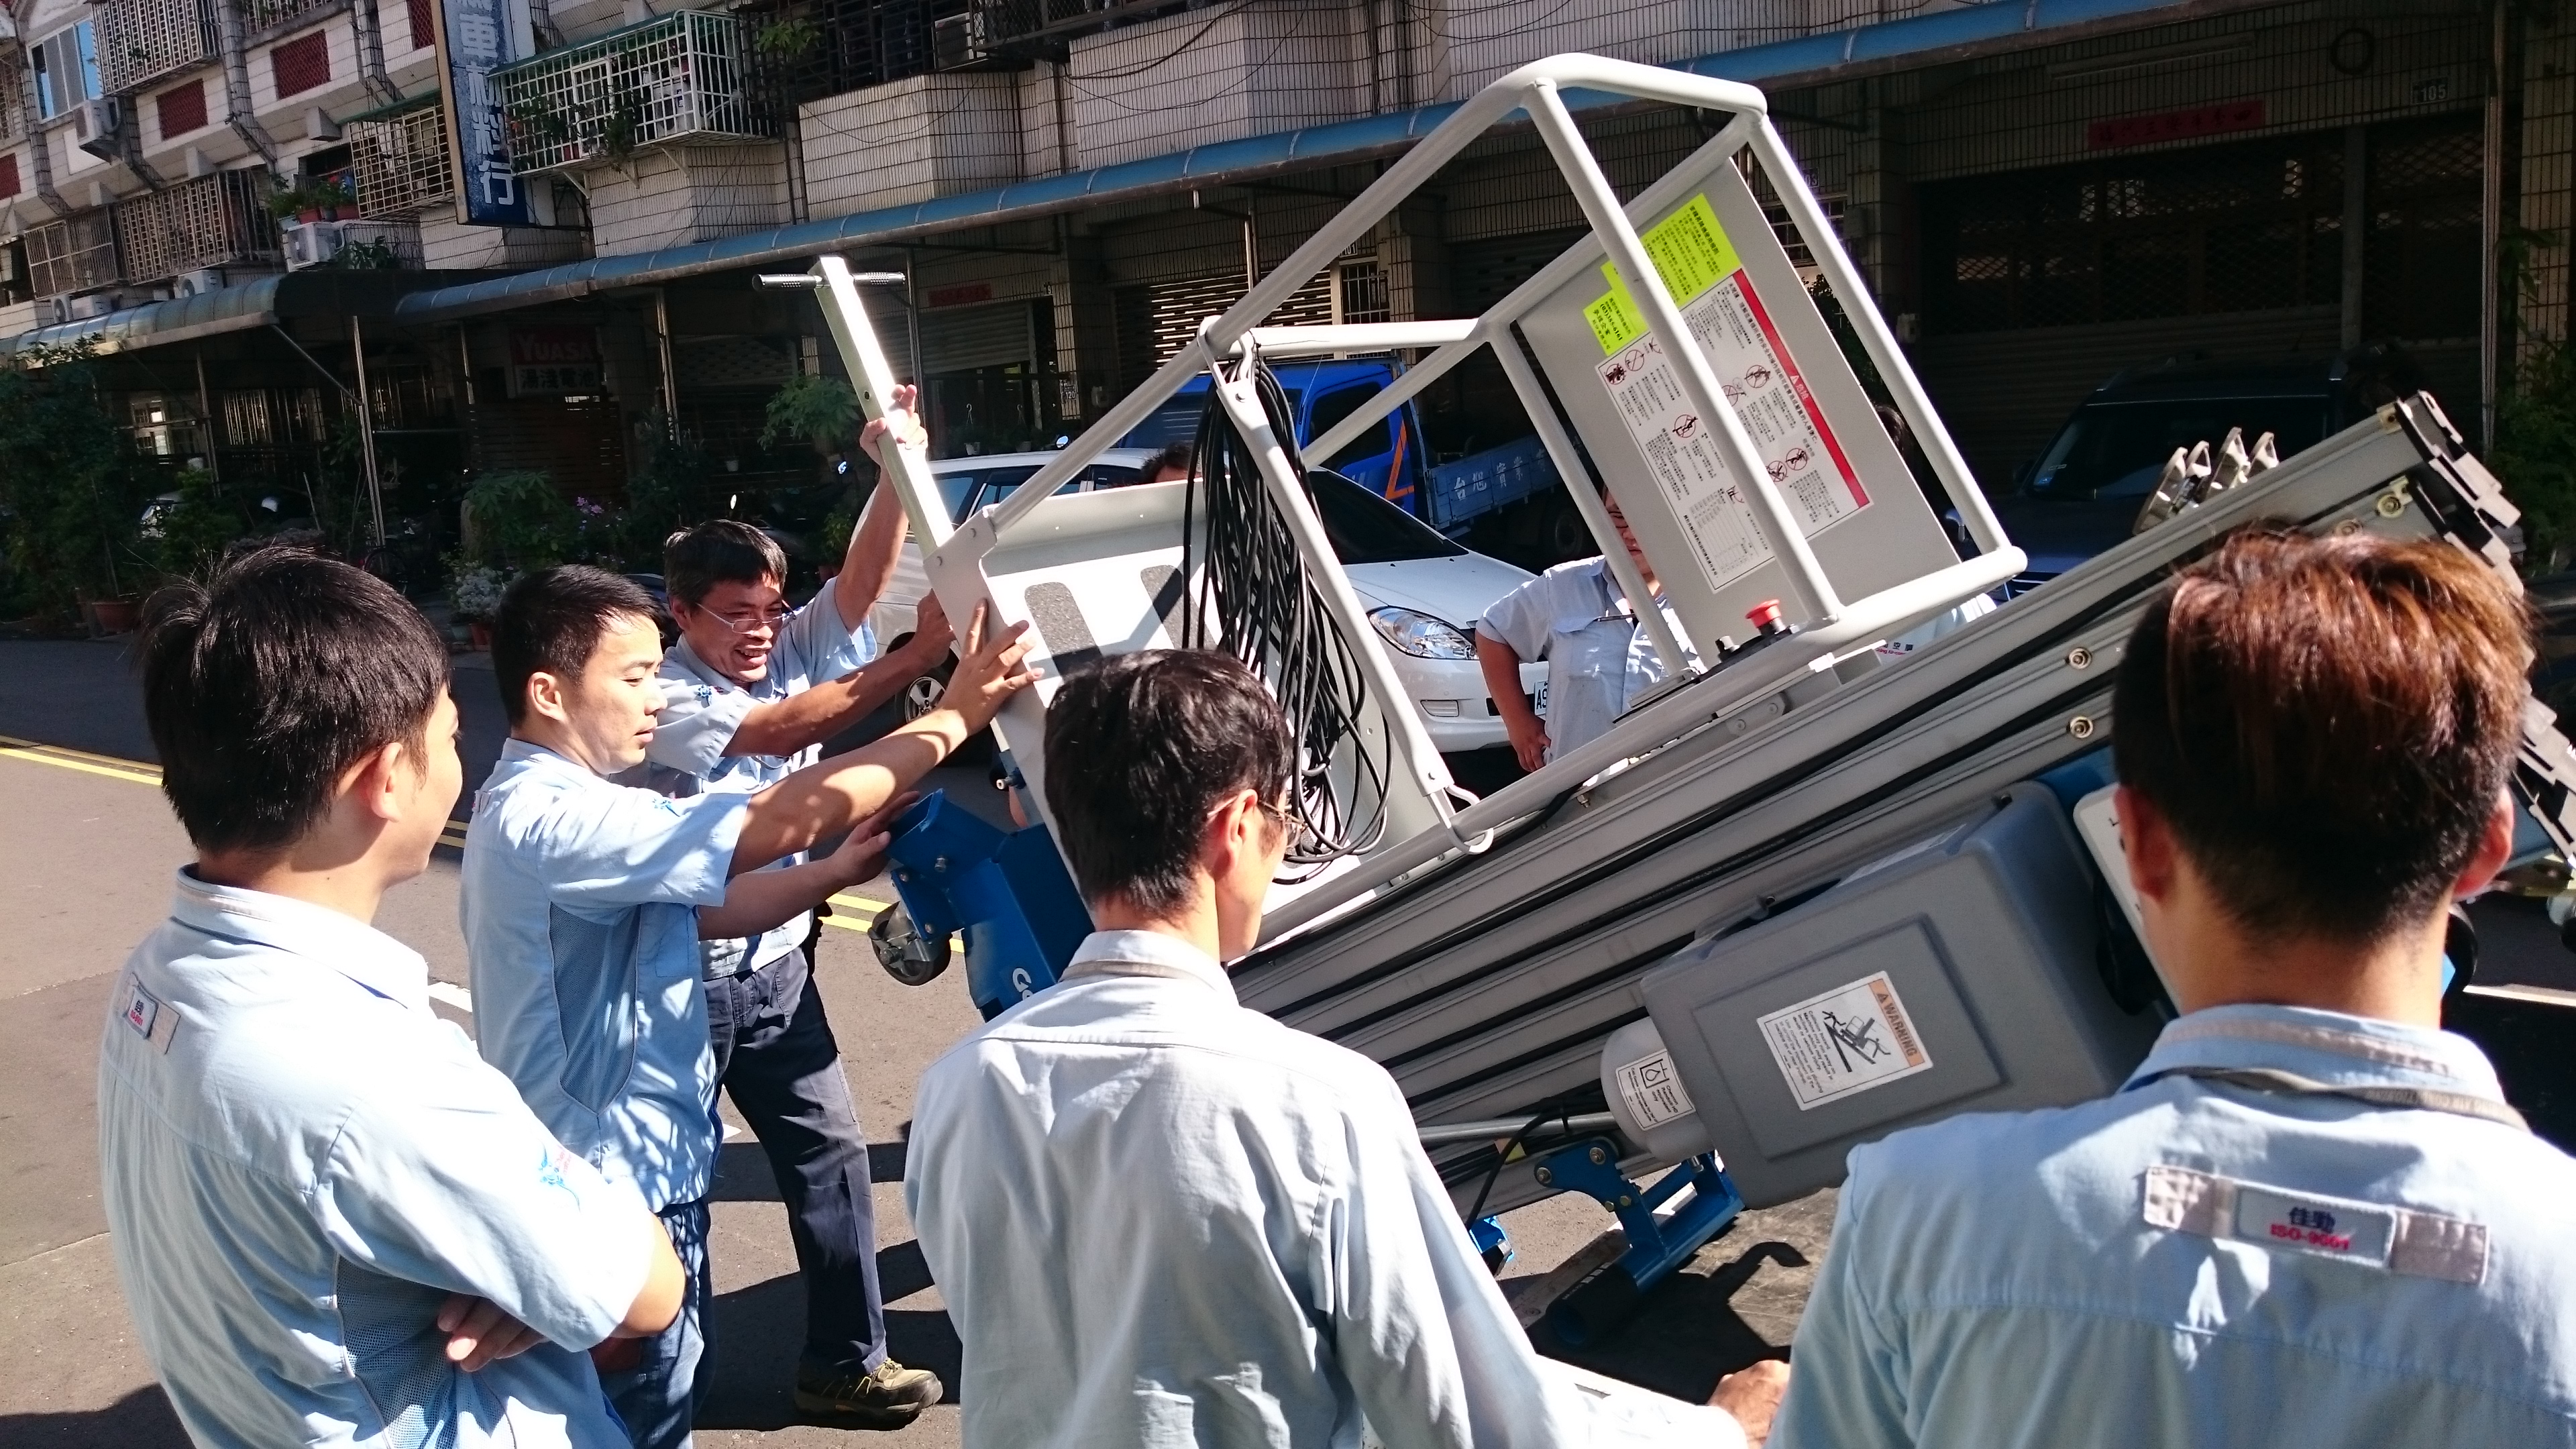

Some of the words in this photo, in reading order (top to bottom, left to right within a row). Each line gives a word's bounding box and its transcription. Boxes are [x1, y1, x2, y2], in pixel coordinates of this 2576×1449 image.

[2421, 84, 2447, 101] 105
[515, 333, 594, 362] YUASA
[1792, 1016, 1801, 1030] death
[1883, 1002, 1917, 1057] WARNING
[1803, 1012, 1815, 1032] Machine
[1824, 1054, 1832, 1067] away
[1807, 1034, 1817, 1049] which
[1821, 1061, 1830, 1075] result
[1656, 1089, 1671, 1113] equivalent
[2270, 1223, 2349, 1250] ISO-9001
